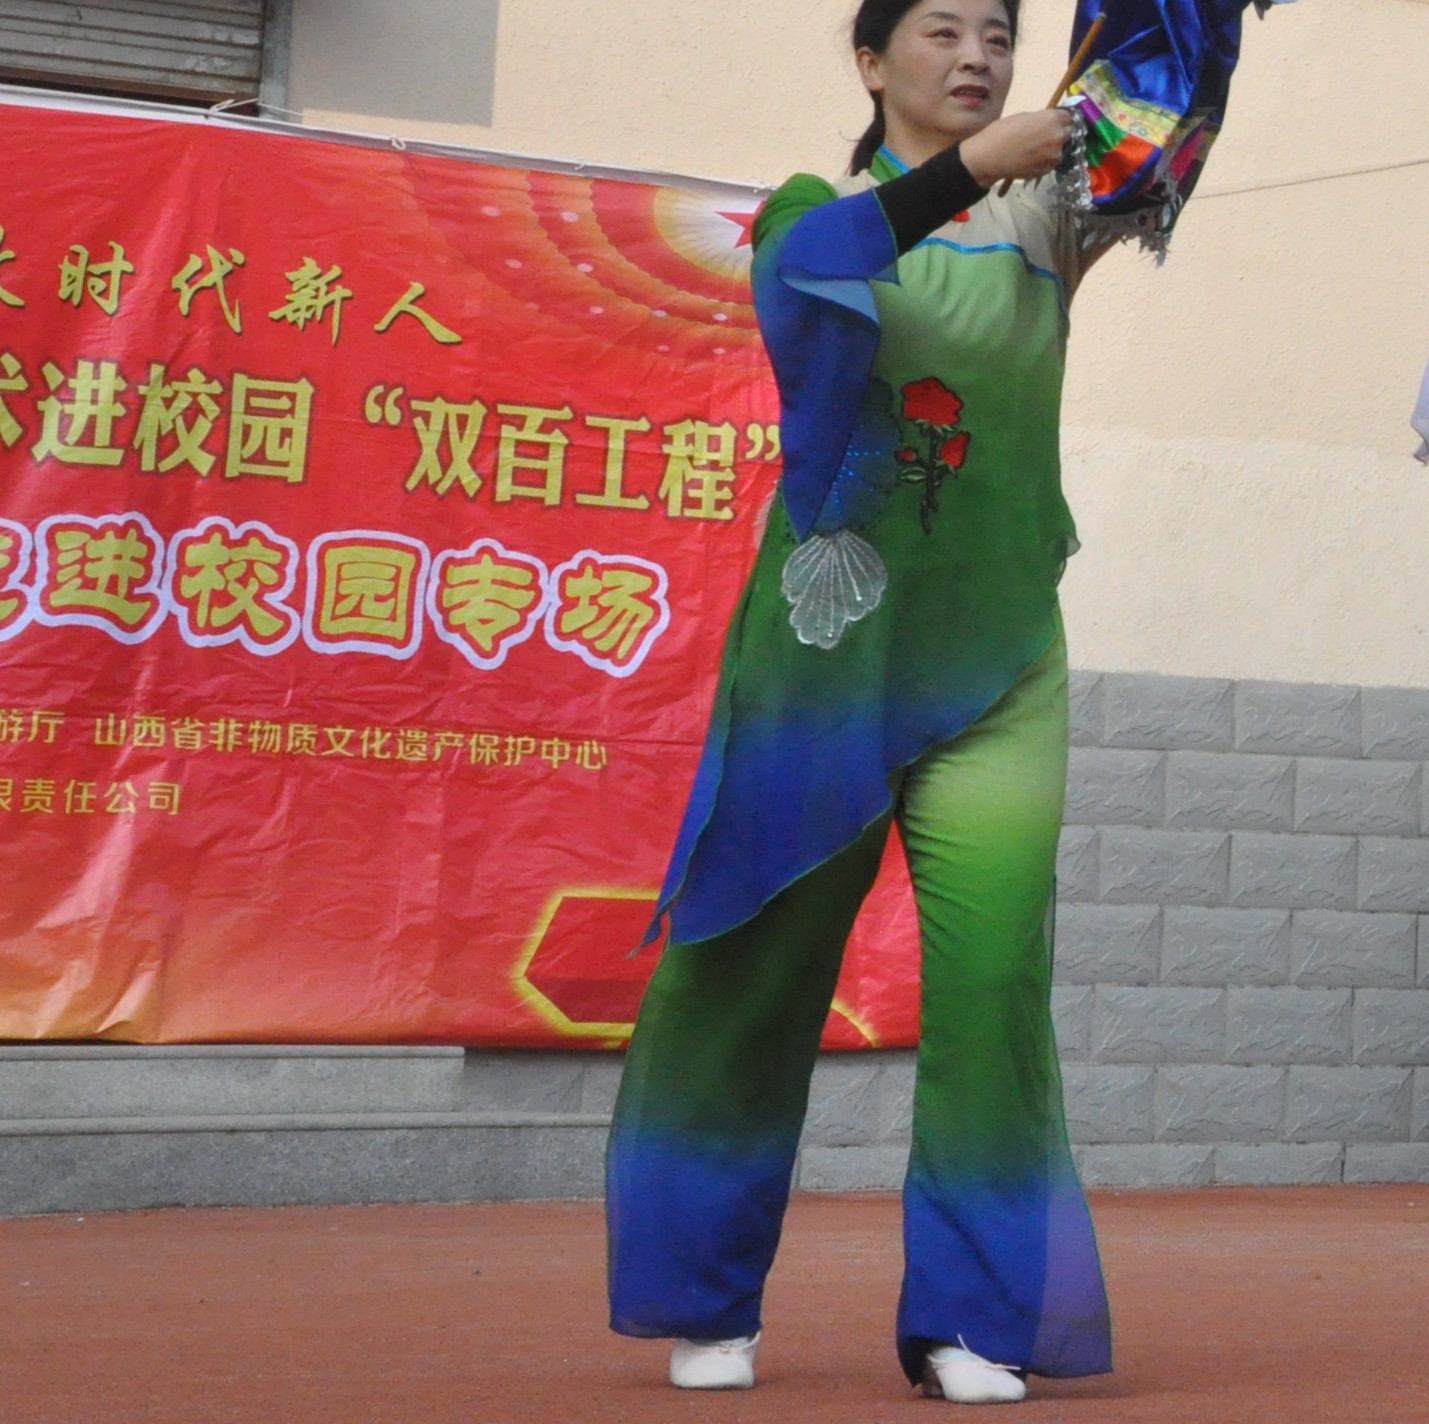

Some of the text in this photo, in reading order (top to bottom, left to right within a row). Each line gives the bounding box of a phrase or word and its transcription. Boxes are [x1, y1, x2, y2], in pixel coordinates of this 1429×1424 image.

[0, 518, 664, 670] 进校园专场
[95, 713, 608, 770] 山西省非物质文化遗产保护中心
